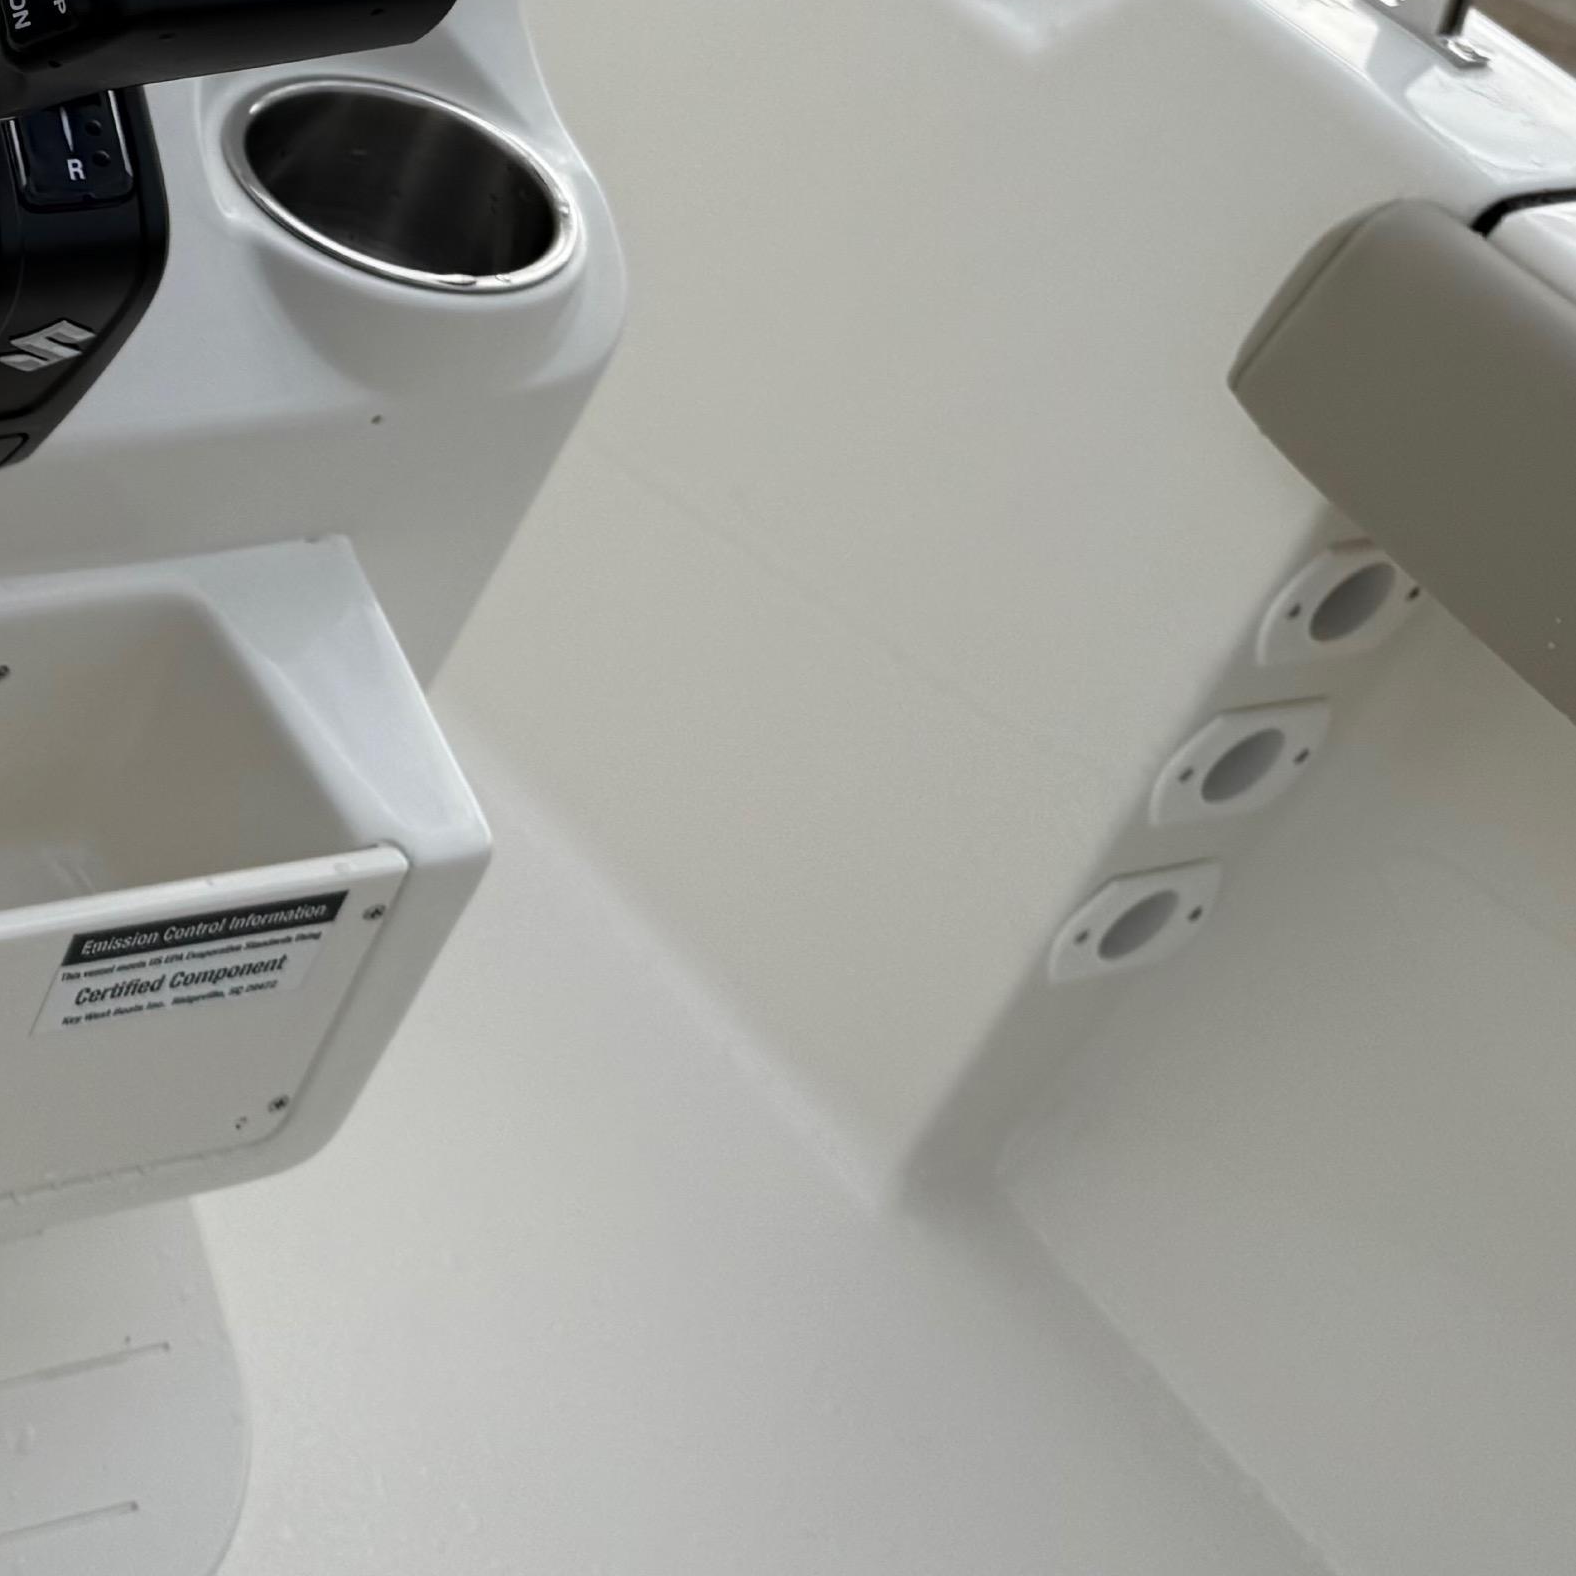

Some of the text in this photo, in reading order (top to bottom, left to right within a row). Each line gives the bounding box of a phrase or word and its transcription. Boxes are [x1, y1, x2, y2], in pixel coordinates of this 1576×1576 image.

[67, 159, 86, 181] R
[81, 902, 328, 956] Emission Control Information
[75, 954, 289, 1005] Certified Component
